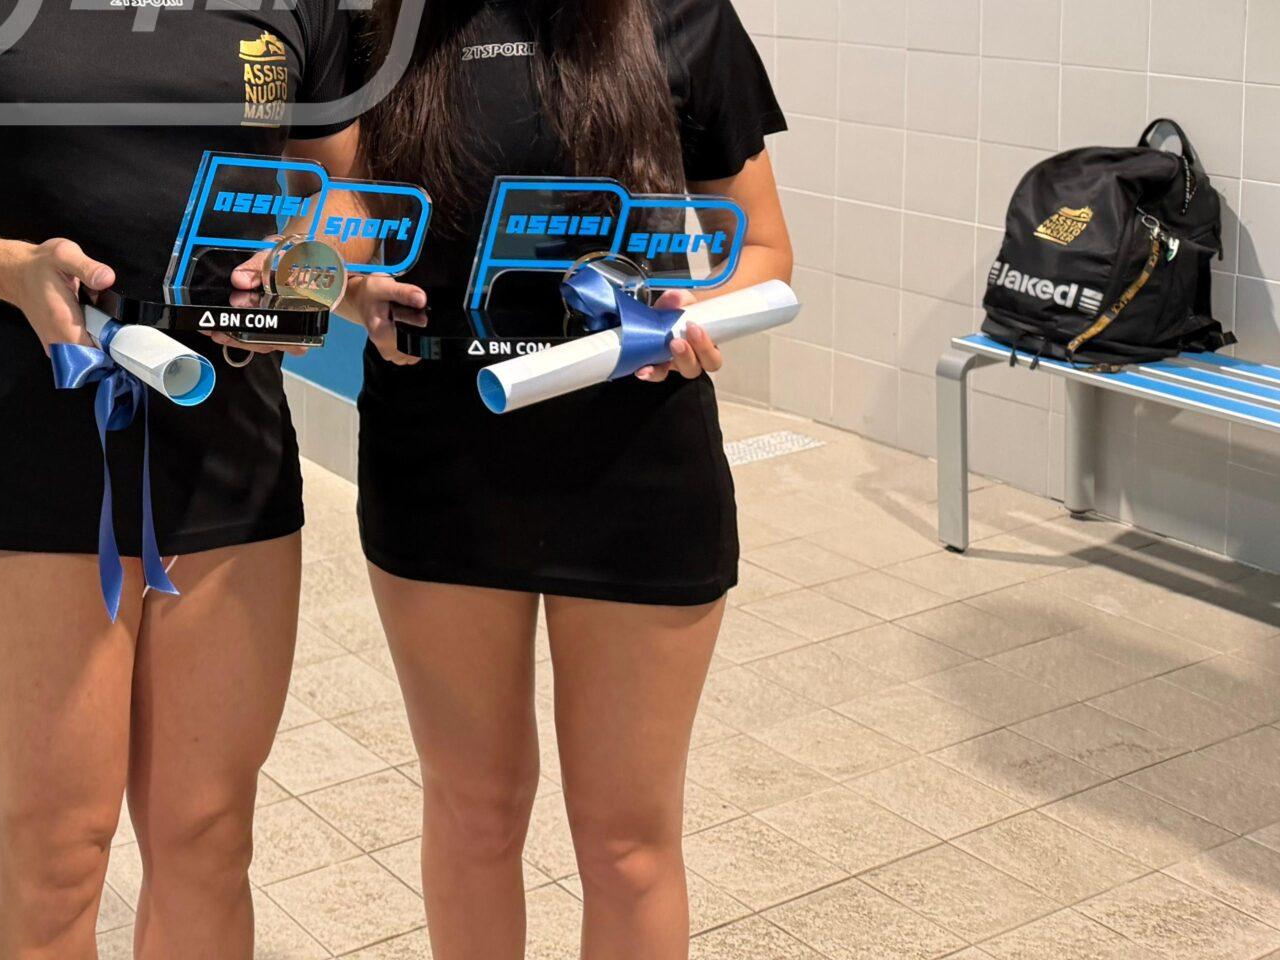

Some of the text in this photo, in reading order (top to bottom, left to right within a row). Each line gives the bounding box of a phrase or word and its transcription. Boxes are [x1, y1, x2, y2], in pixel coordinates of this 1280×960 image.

[245, 81, 287, 104] NUOTO
[323, 216, 413, 244] sport
[627, 230, 727, 260] sport
[219, 313, 278, 329] BN COM
[488, 341, 512, 355] BN
